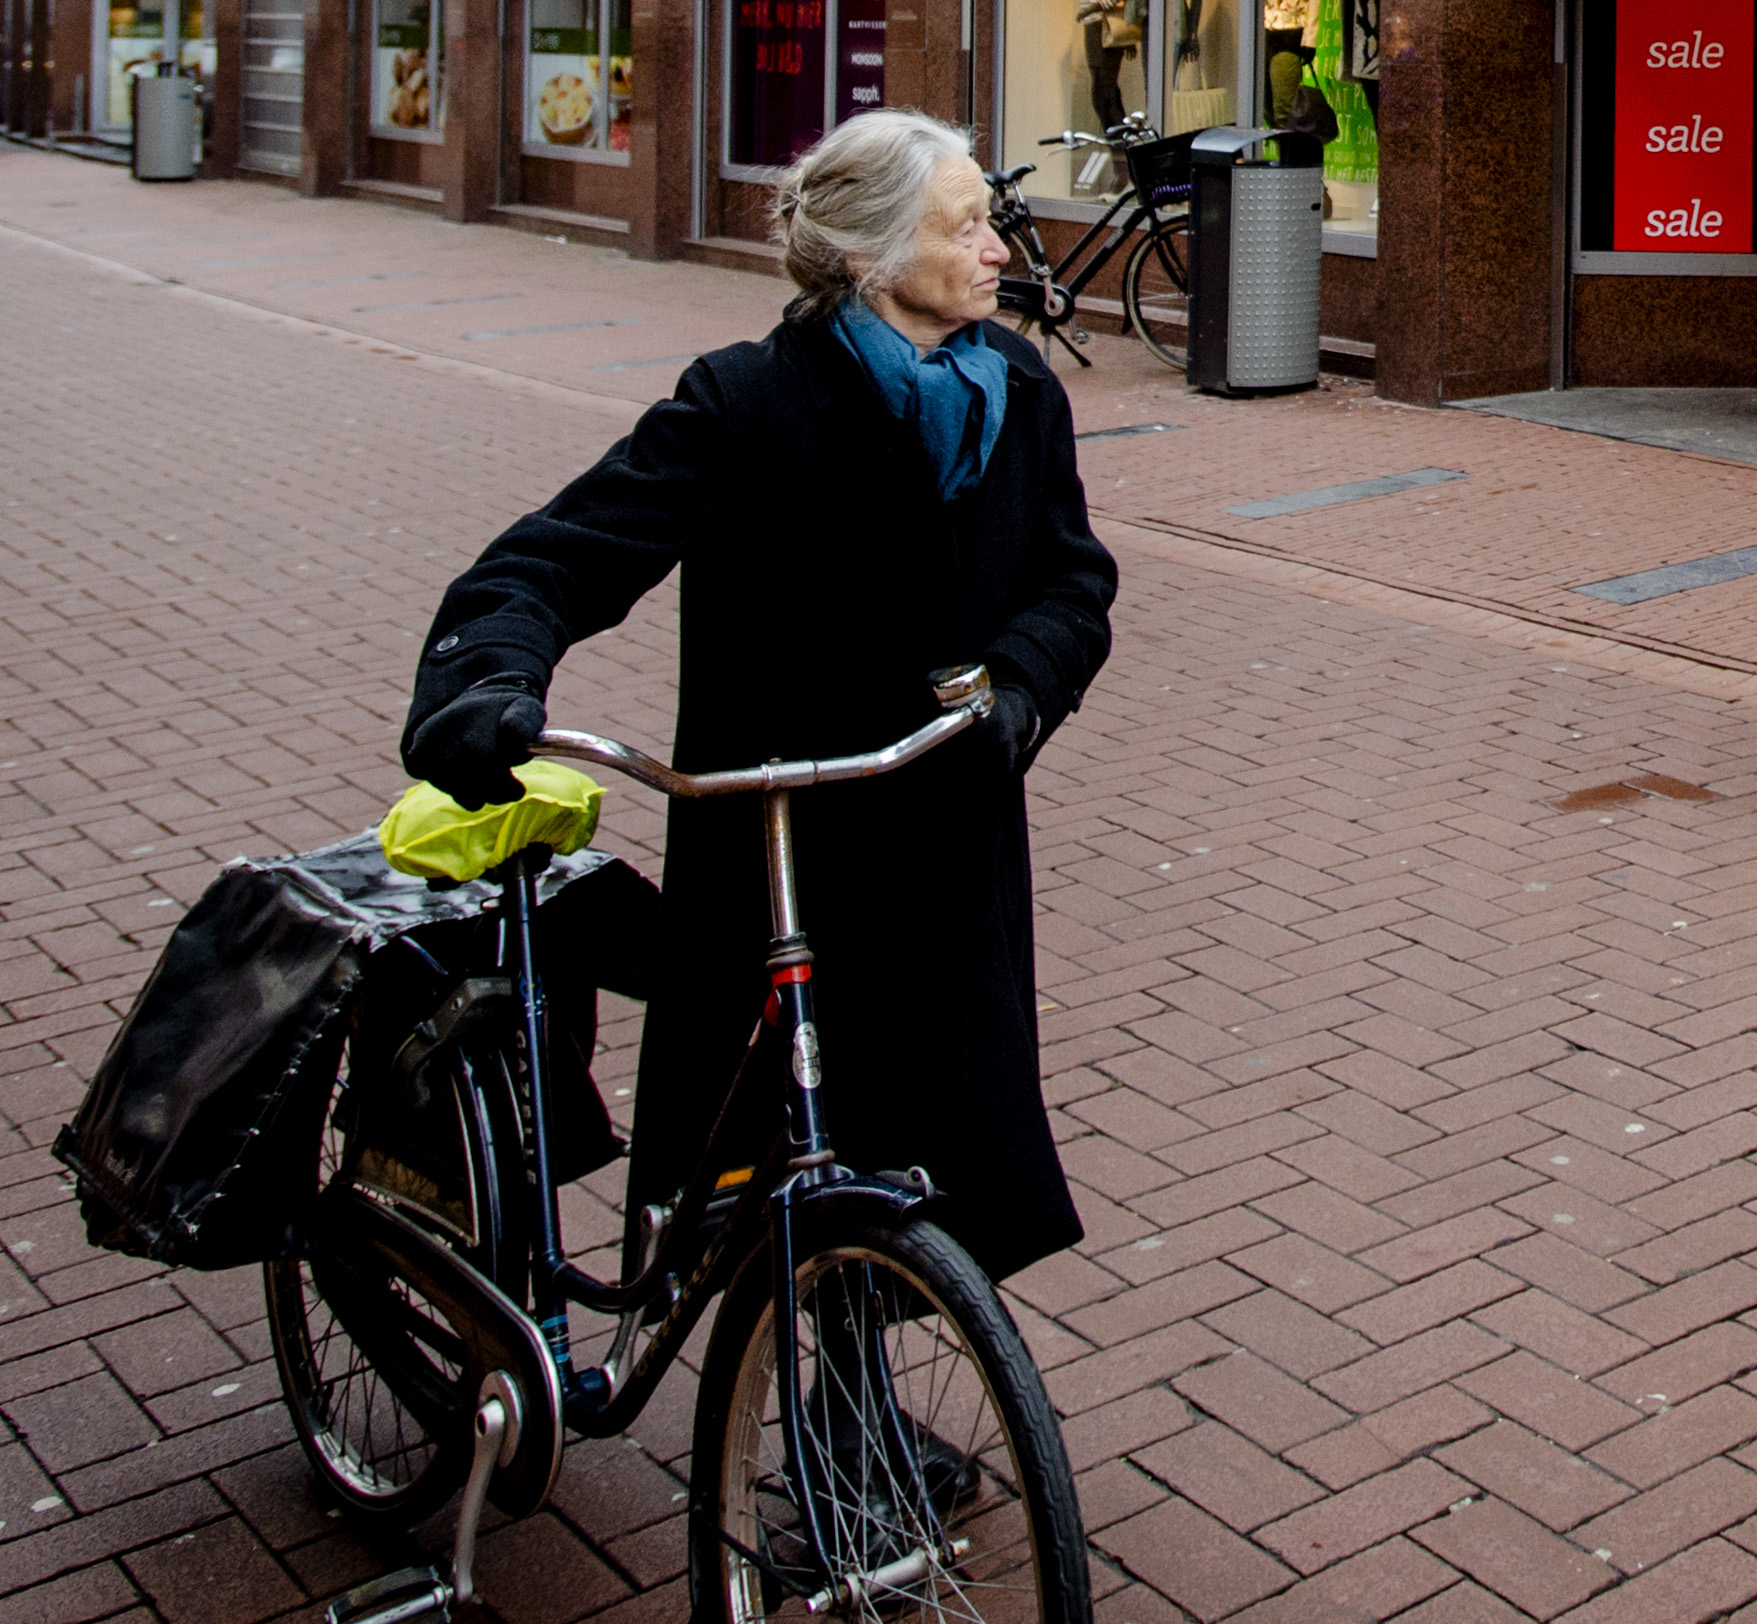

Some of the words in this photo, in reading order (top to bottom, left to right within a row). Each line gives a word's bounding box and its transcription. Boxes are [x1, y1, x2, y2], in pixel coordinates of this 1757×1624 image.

[1646, 30, 1724, 69] sale
[1645, 114, 1724, 153] sale
[1644, 198, 1723, 237] sale
[514, 1027, 538, 1188] GAZELLE
